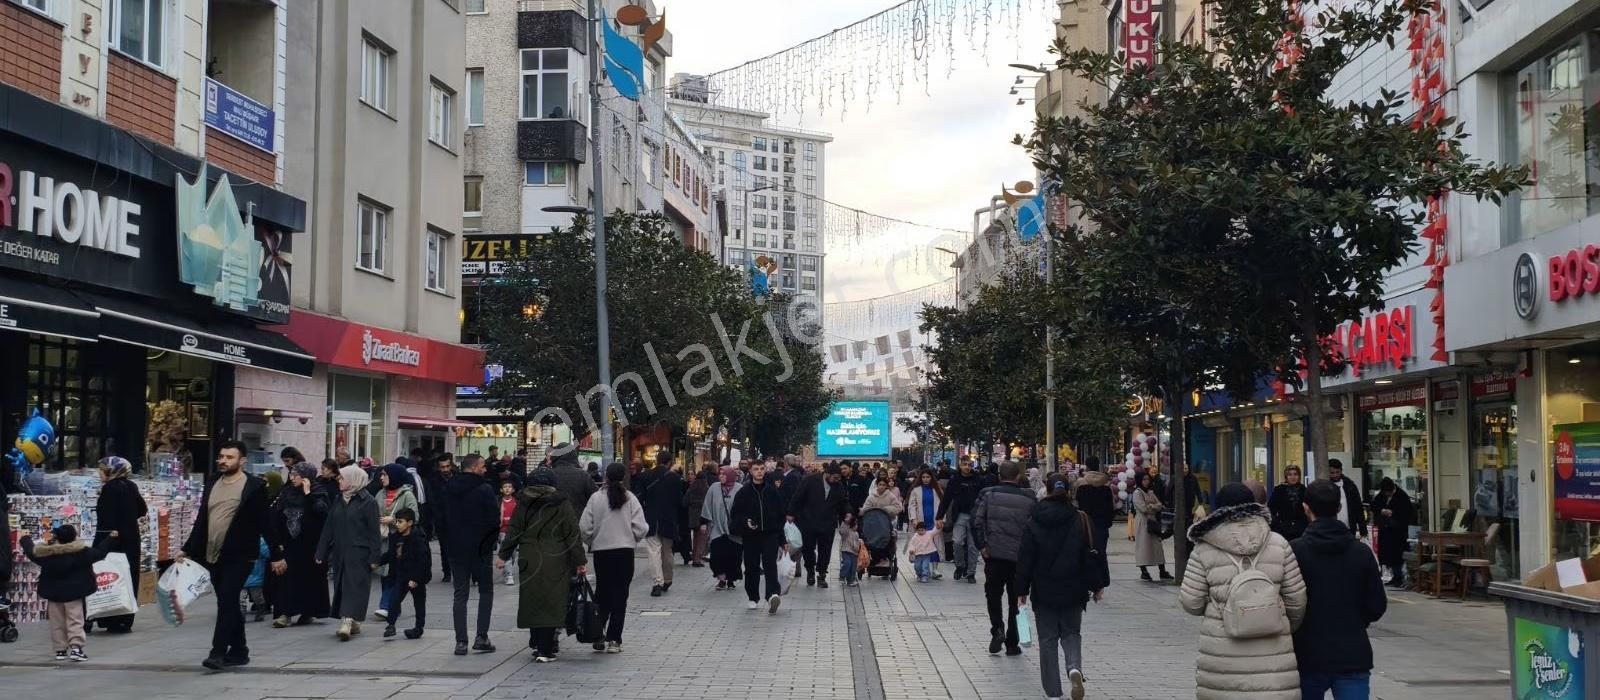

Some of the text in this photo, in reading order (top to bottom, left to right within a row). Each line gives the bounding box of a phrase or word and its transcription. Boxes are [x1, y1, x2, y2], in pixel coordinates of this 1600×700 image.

[18, 170, 141, 259] HOME
[4, 240, 33, 259] DEĞER
[34, 248, 60, 265] KATAR
[223, 343, 247, 358] HOME
[1348, 304, 1412, 378] ÇARŞI
[1529, 650, 1553, 669] Temiz
[1535, 662, 1566, 689] Esenler
